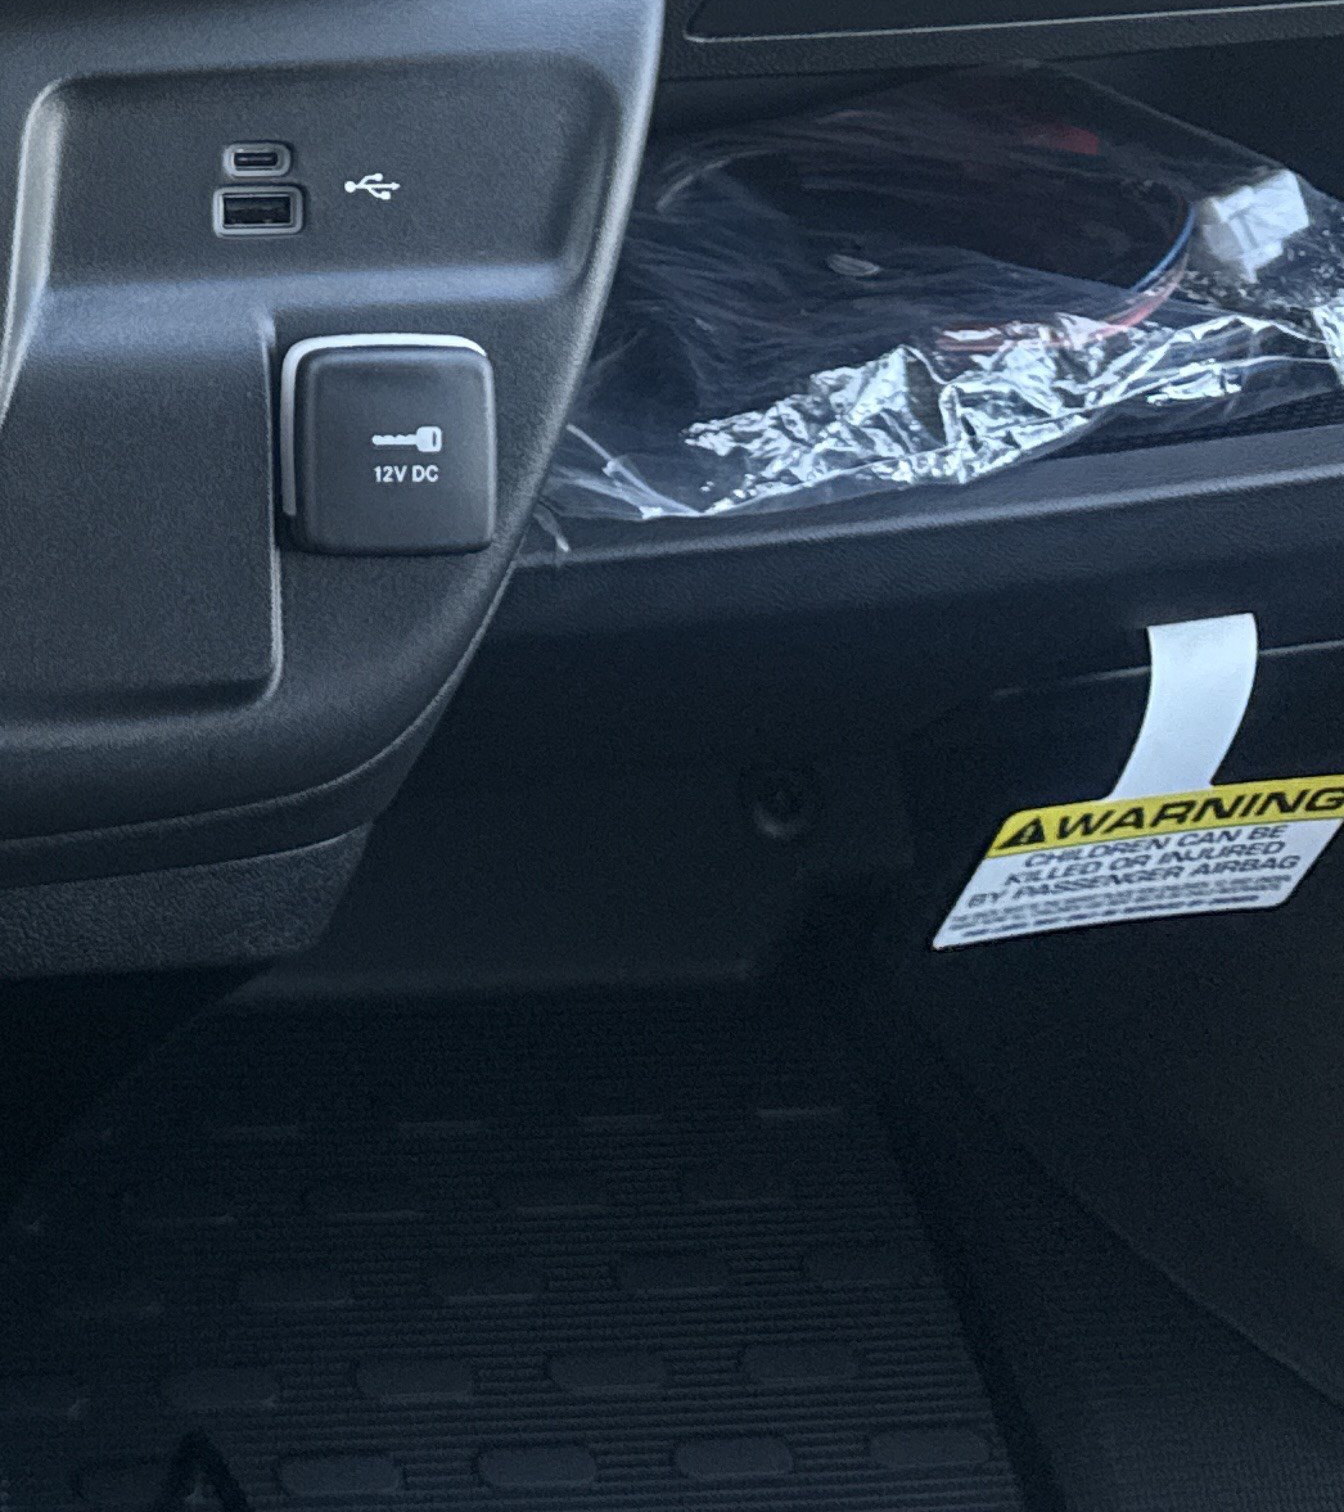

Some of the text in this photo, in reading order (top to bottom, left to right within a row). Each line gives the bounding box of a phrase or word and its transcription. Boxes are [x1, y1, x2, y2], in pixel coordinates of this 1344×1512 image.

[373, 464, 439, 483] 12V DC
[1055, 787, 1344, 840] WARNING
[1004, 841, 1286, 886] KILLED OR INJURED
[1023, 825, 1288, 868] CHILDREN CAN BE
[968, 855, 1301, 909] BY PASSENGER AIRBAG
